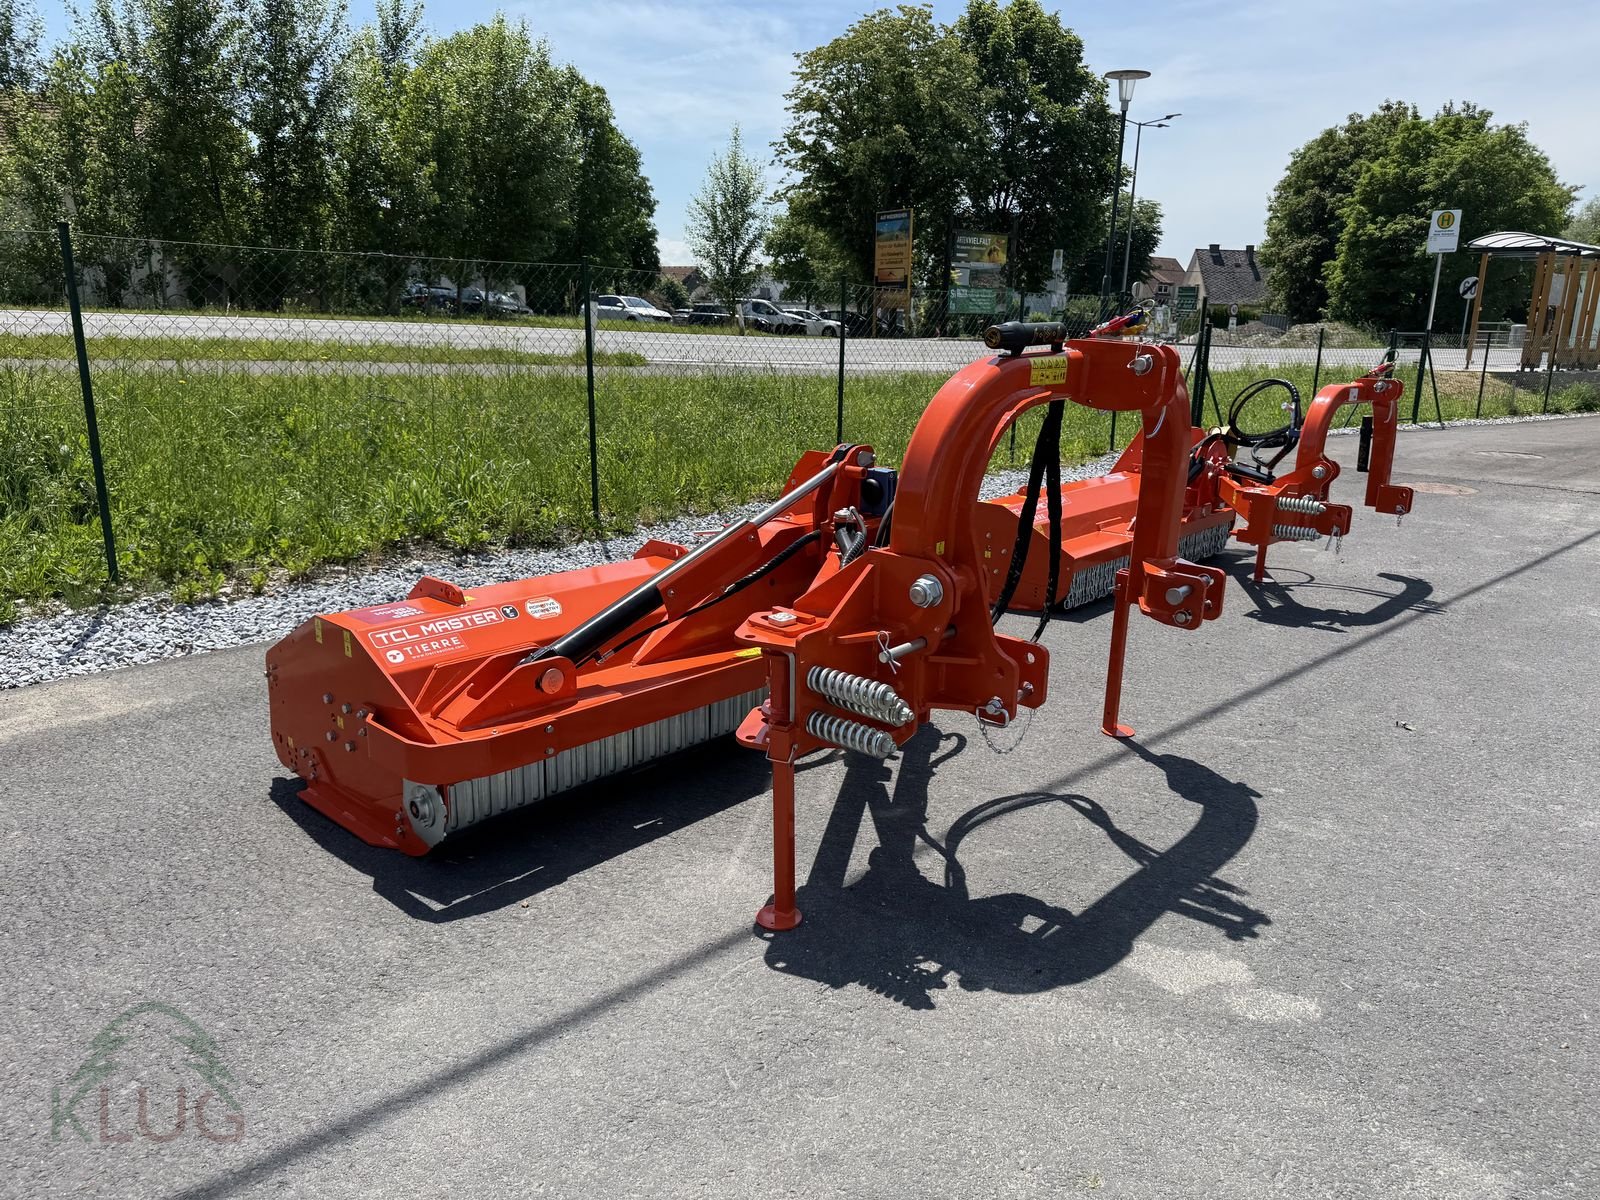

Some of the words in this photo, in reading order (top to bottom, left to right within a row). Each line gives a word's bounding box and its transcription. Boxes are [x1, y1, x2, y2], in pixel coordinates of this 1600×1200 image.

[1441, 214, 1452, 226] H
[375, 627, 420, 645] TCL
[420, 612, 499, 636] MASTER
[403, 636, 461, 655] TIERRE
